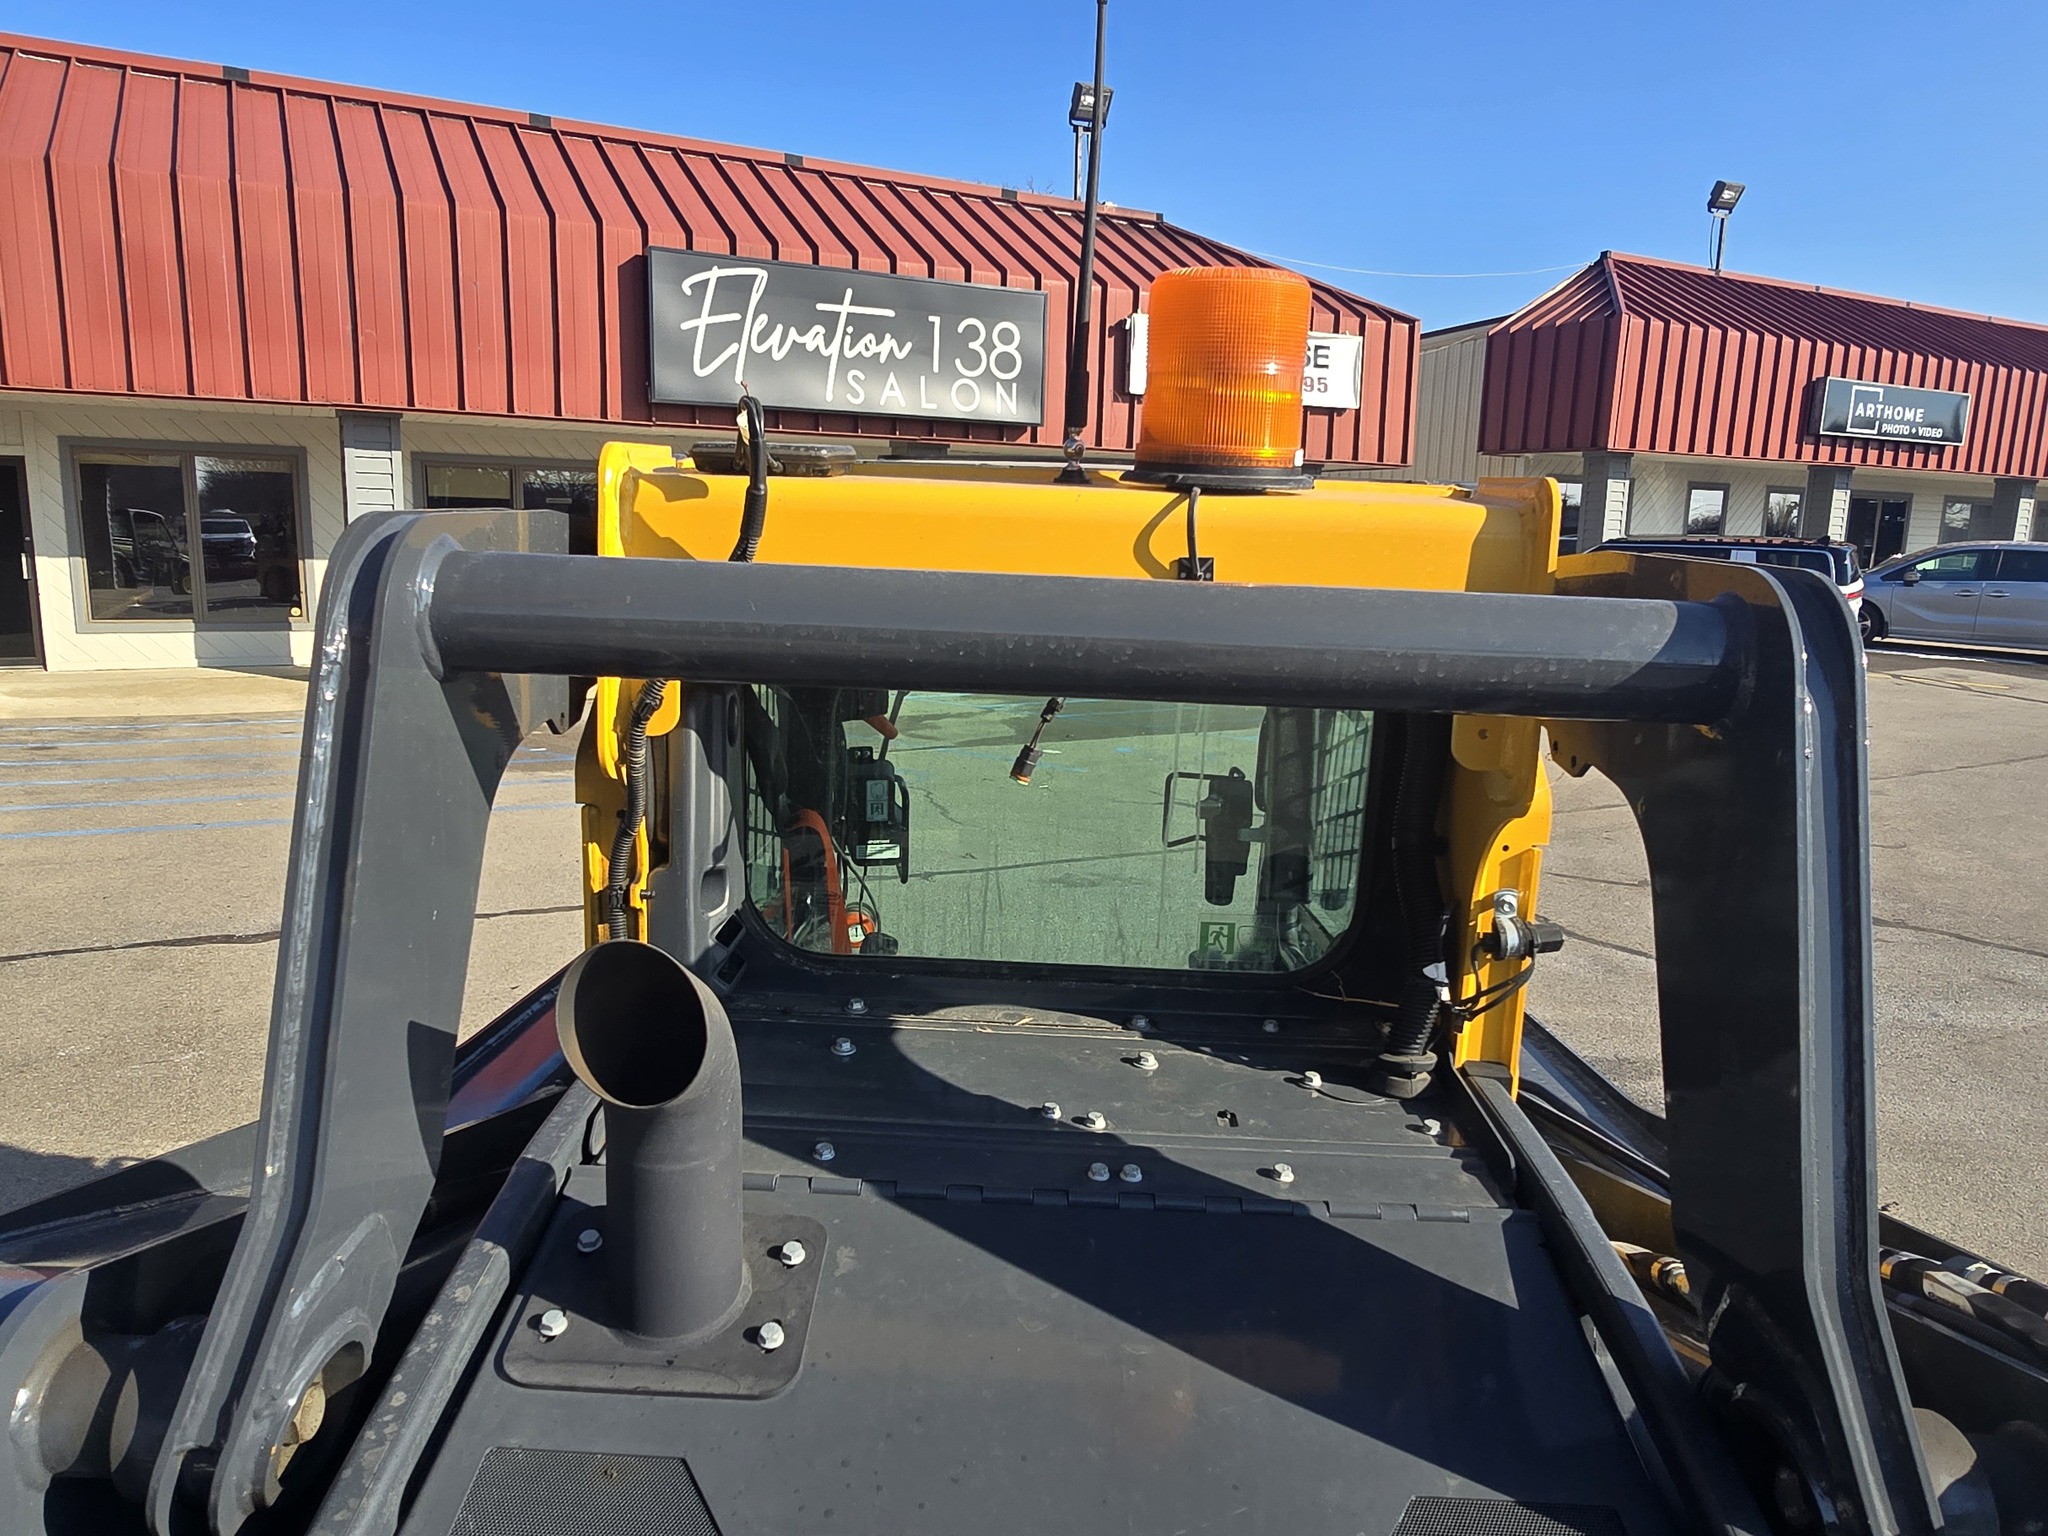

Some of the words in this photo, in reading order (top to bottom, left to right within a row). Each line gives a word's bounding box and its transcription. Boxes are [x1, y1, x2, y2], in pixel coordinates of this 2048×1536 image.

[680, 265, 913, 402] Elevation
[928, 316, 1023, 380] 138
[845, 369, 1018, 415] SALON
[1855, 403, 1924, 422] ARTHOME
[1881, 423, 1909, 435] PHOTO
[1918, 426, 1943, 438] VIDEO
